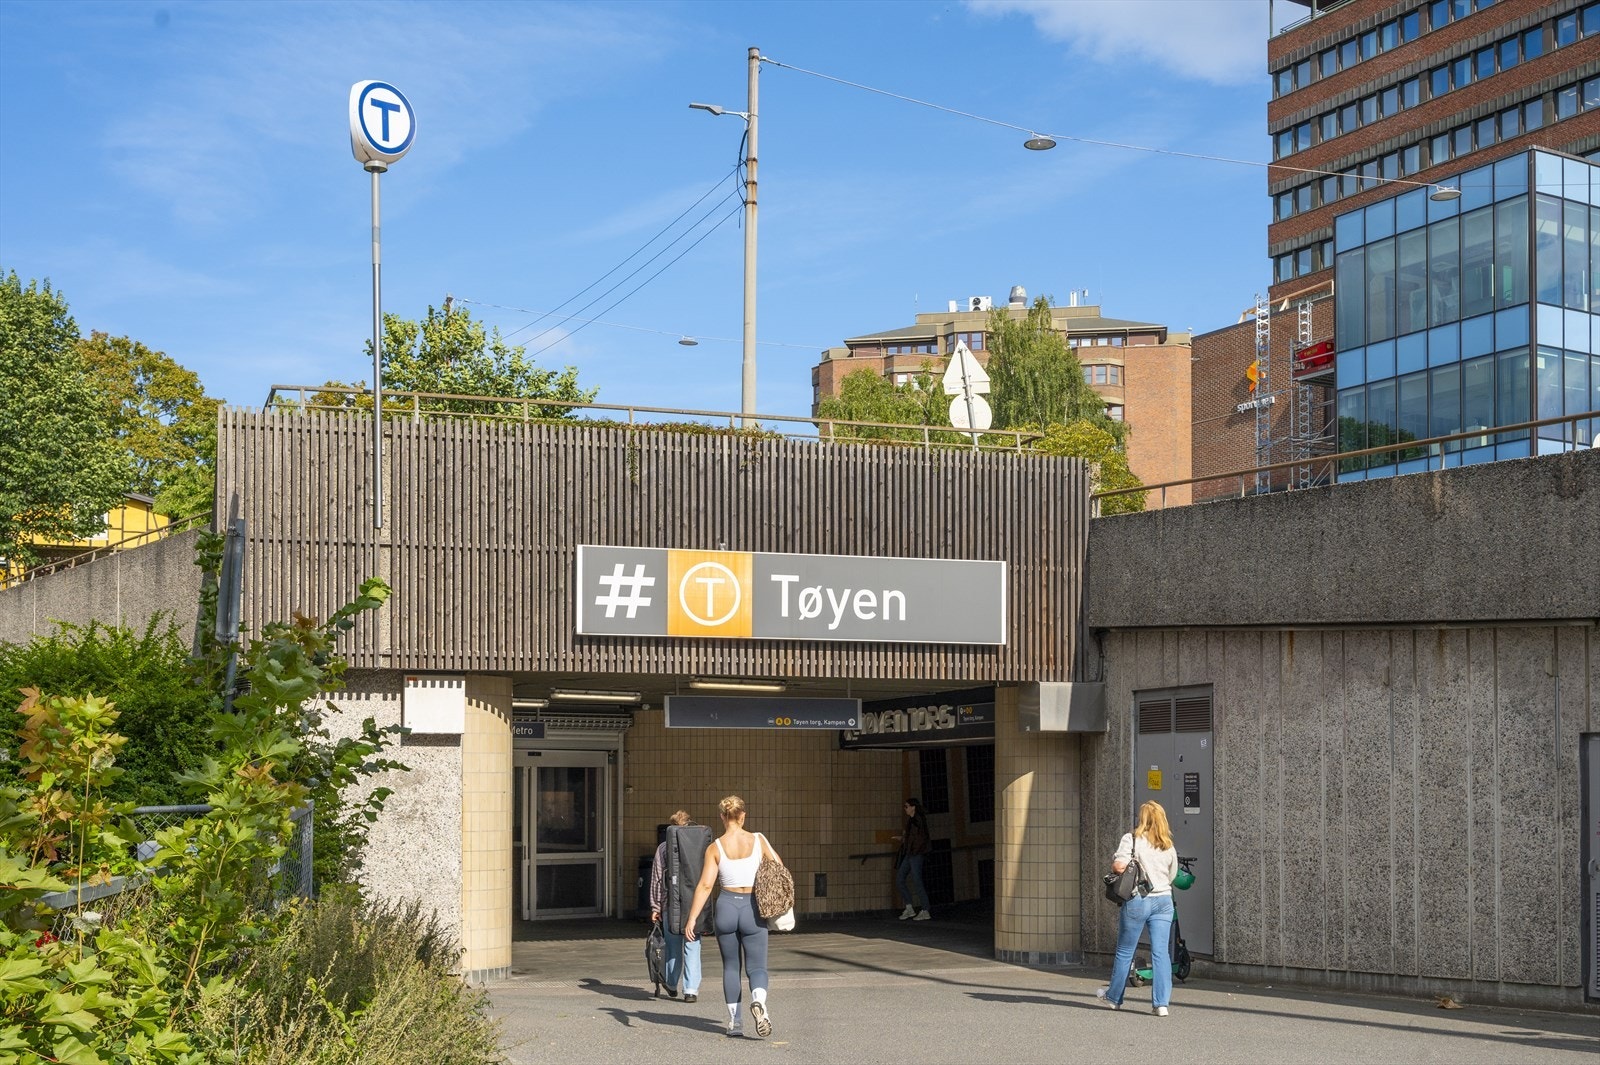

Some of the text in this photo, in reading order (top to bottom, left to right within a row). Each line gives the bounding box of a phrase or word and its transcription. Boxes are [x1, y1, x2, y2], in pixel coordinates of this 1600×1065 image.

[371, 98, 400, 142] T
[695, 577, 726, 618] T
[770, 574, 906, 630] Tøyen
[793, 718, 809, 726] Tøyen
[824, 719, 846, 727] Kampen
